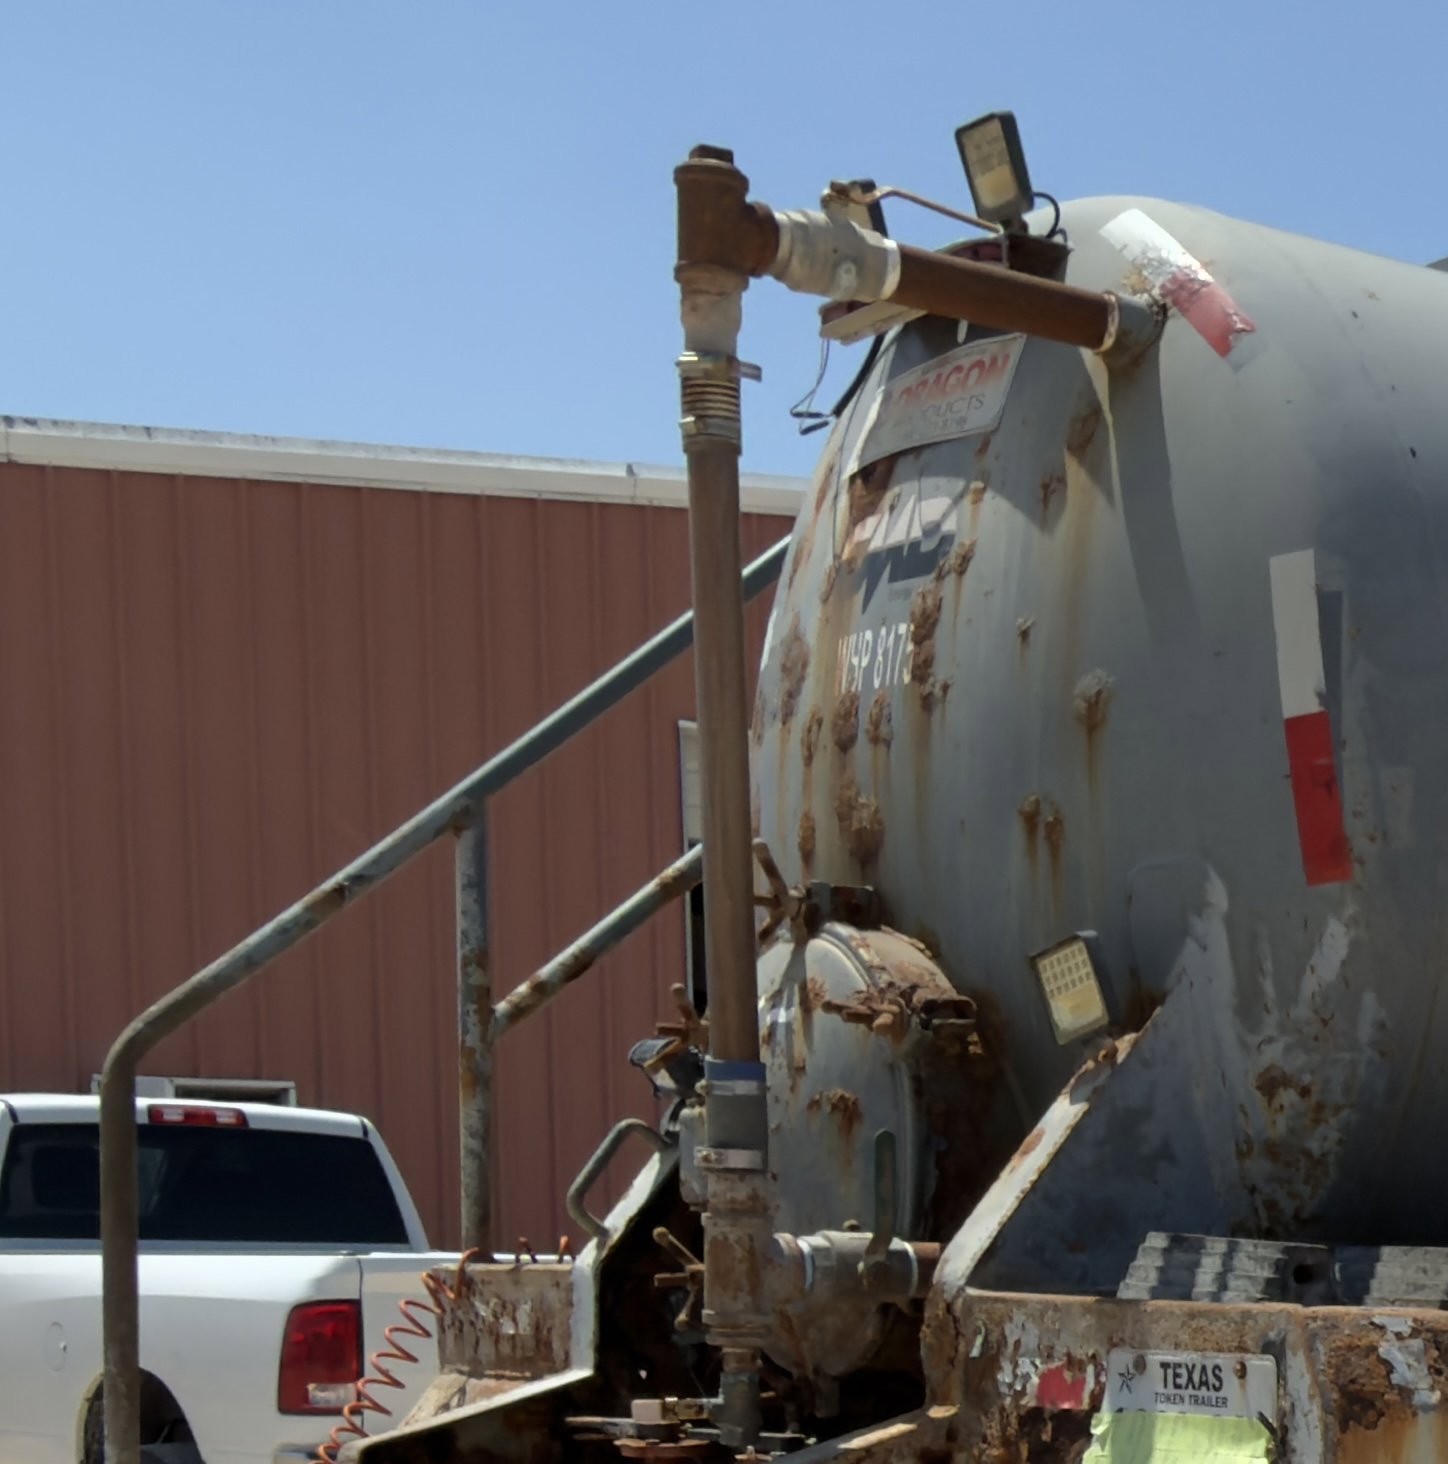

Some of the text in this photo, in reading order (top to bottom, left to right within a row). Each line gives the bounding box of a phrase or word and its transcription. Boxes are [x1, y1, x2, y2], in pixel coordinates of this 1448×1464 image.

[1158, 1361, 1224, 1393] TEXAS
[1153, 1391, 1229, 1409] TOKEN TRAILER
